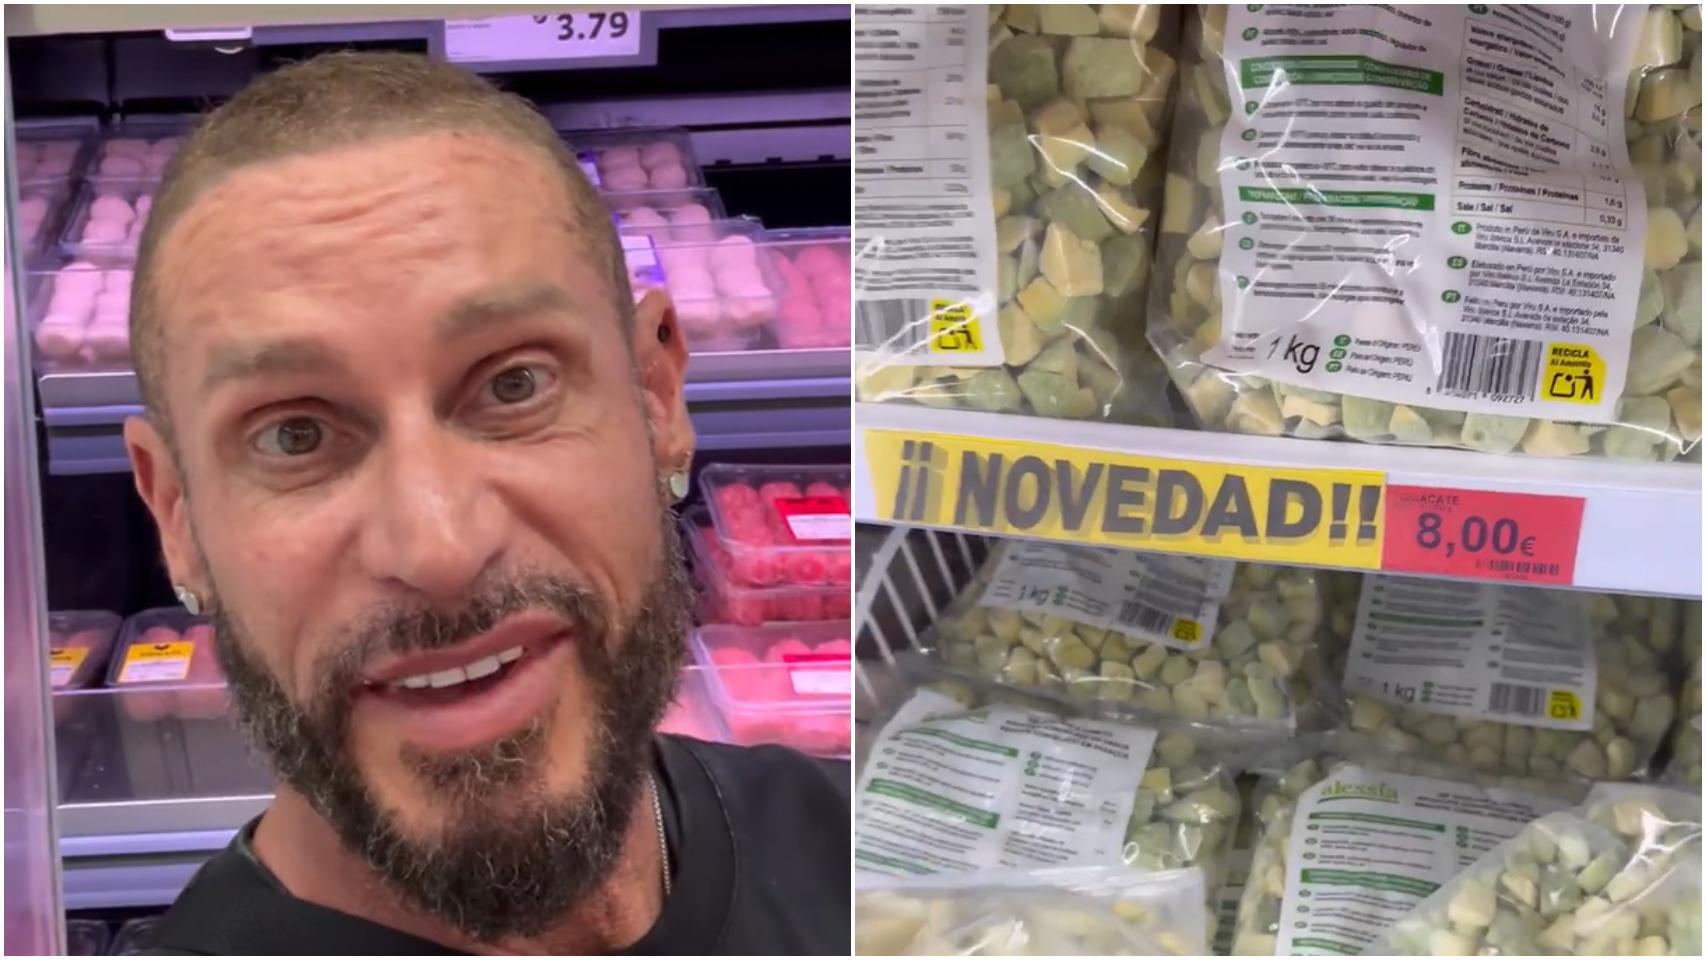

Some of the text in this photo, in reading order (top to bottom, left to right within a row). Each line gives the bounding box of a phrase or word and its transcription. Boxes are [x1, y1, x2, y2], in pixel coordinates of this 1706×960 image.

[557, 12, 629, 40] 3.79
[1266, 335, 1282, 360] 1
[1283, 333, 1321, 374] kg
[1551, 347, 1590, 359] RECICLA
[953, 448, 1381, 545] NOVEDAD!!
[1416, 511, 1537, 557] 8,00€
[1029, 583, 1050, 607] kg
[1381, 681, 1416, 704] 1 kg
